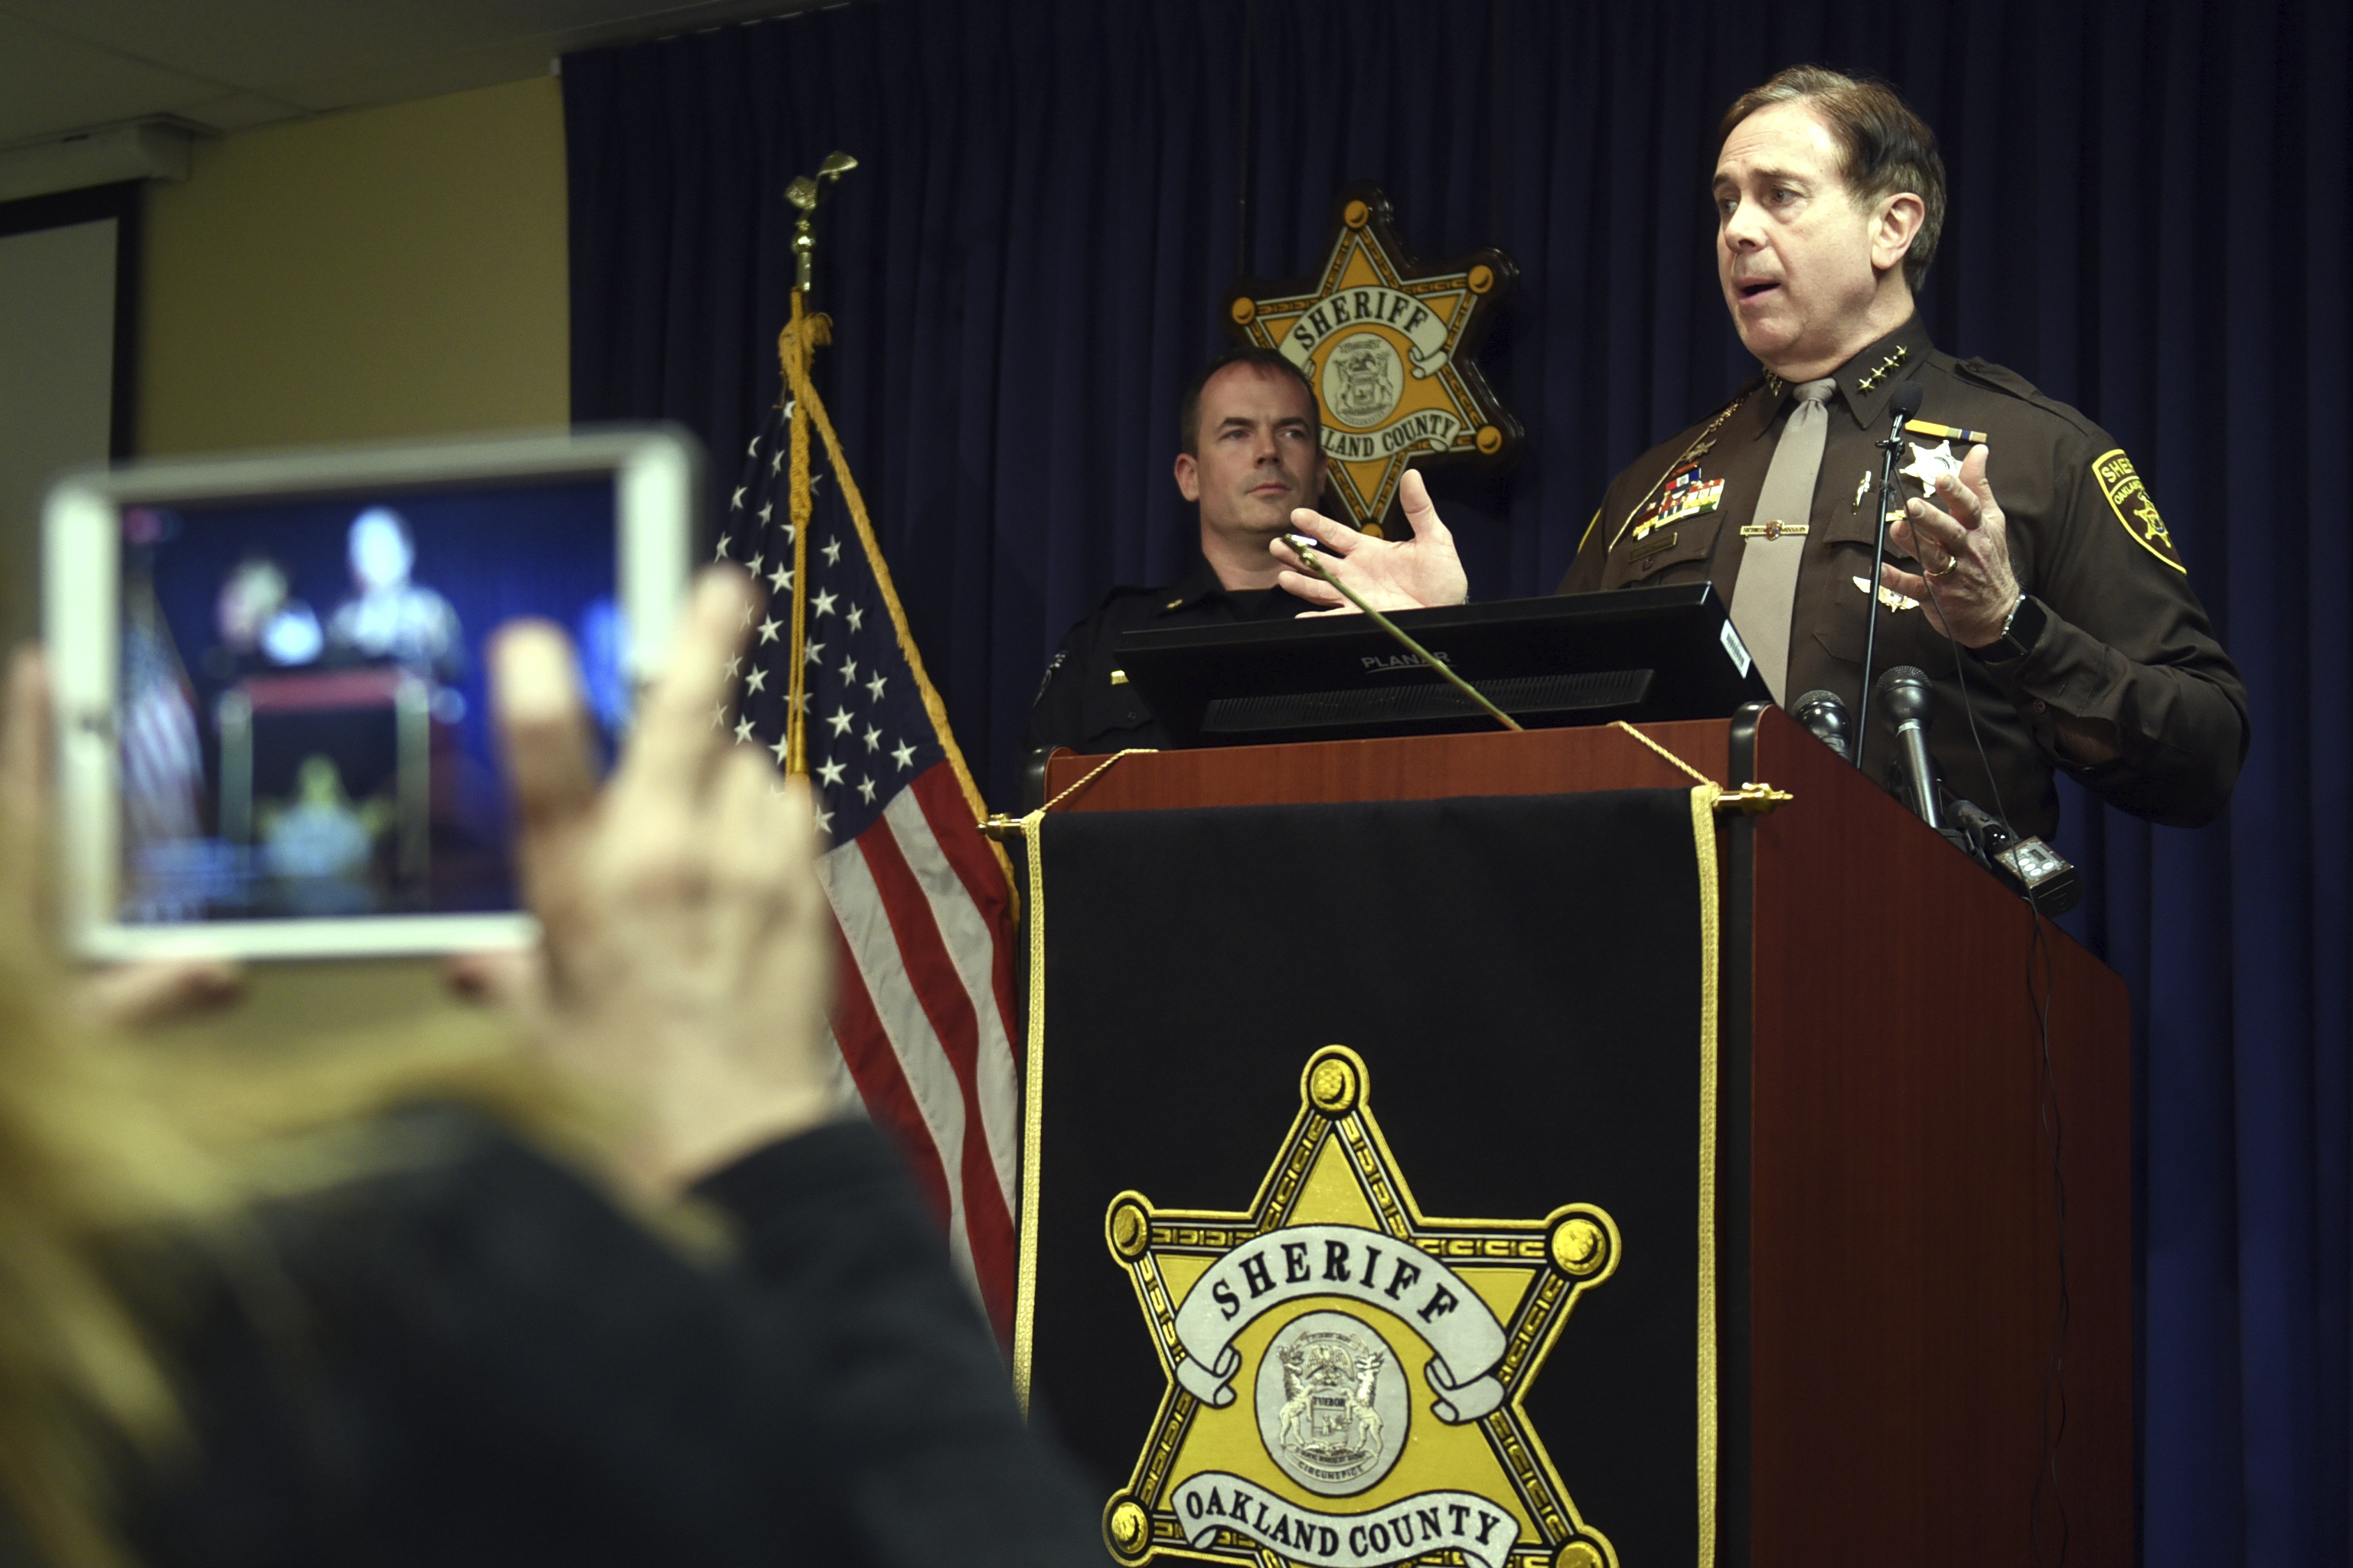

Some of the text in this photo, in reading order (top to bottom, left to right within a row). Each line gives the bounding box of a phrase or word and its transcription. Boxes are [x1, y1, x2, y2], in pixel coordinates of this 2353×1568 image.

[1294, 291, 1428, 351] SHERIFF
[1322, 414, 1456, 458] LAND COUNTY
[1361, 651, 1451, 668] PLANR
[1212, 1240, 1459, 1322] SHERIFF
[1186, 1486, 1500, 1557] OAKLAND COUNTY
